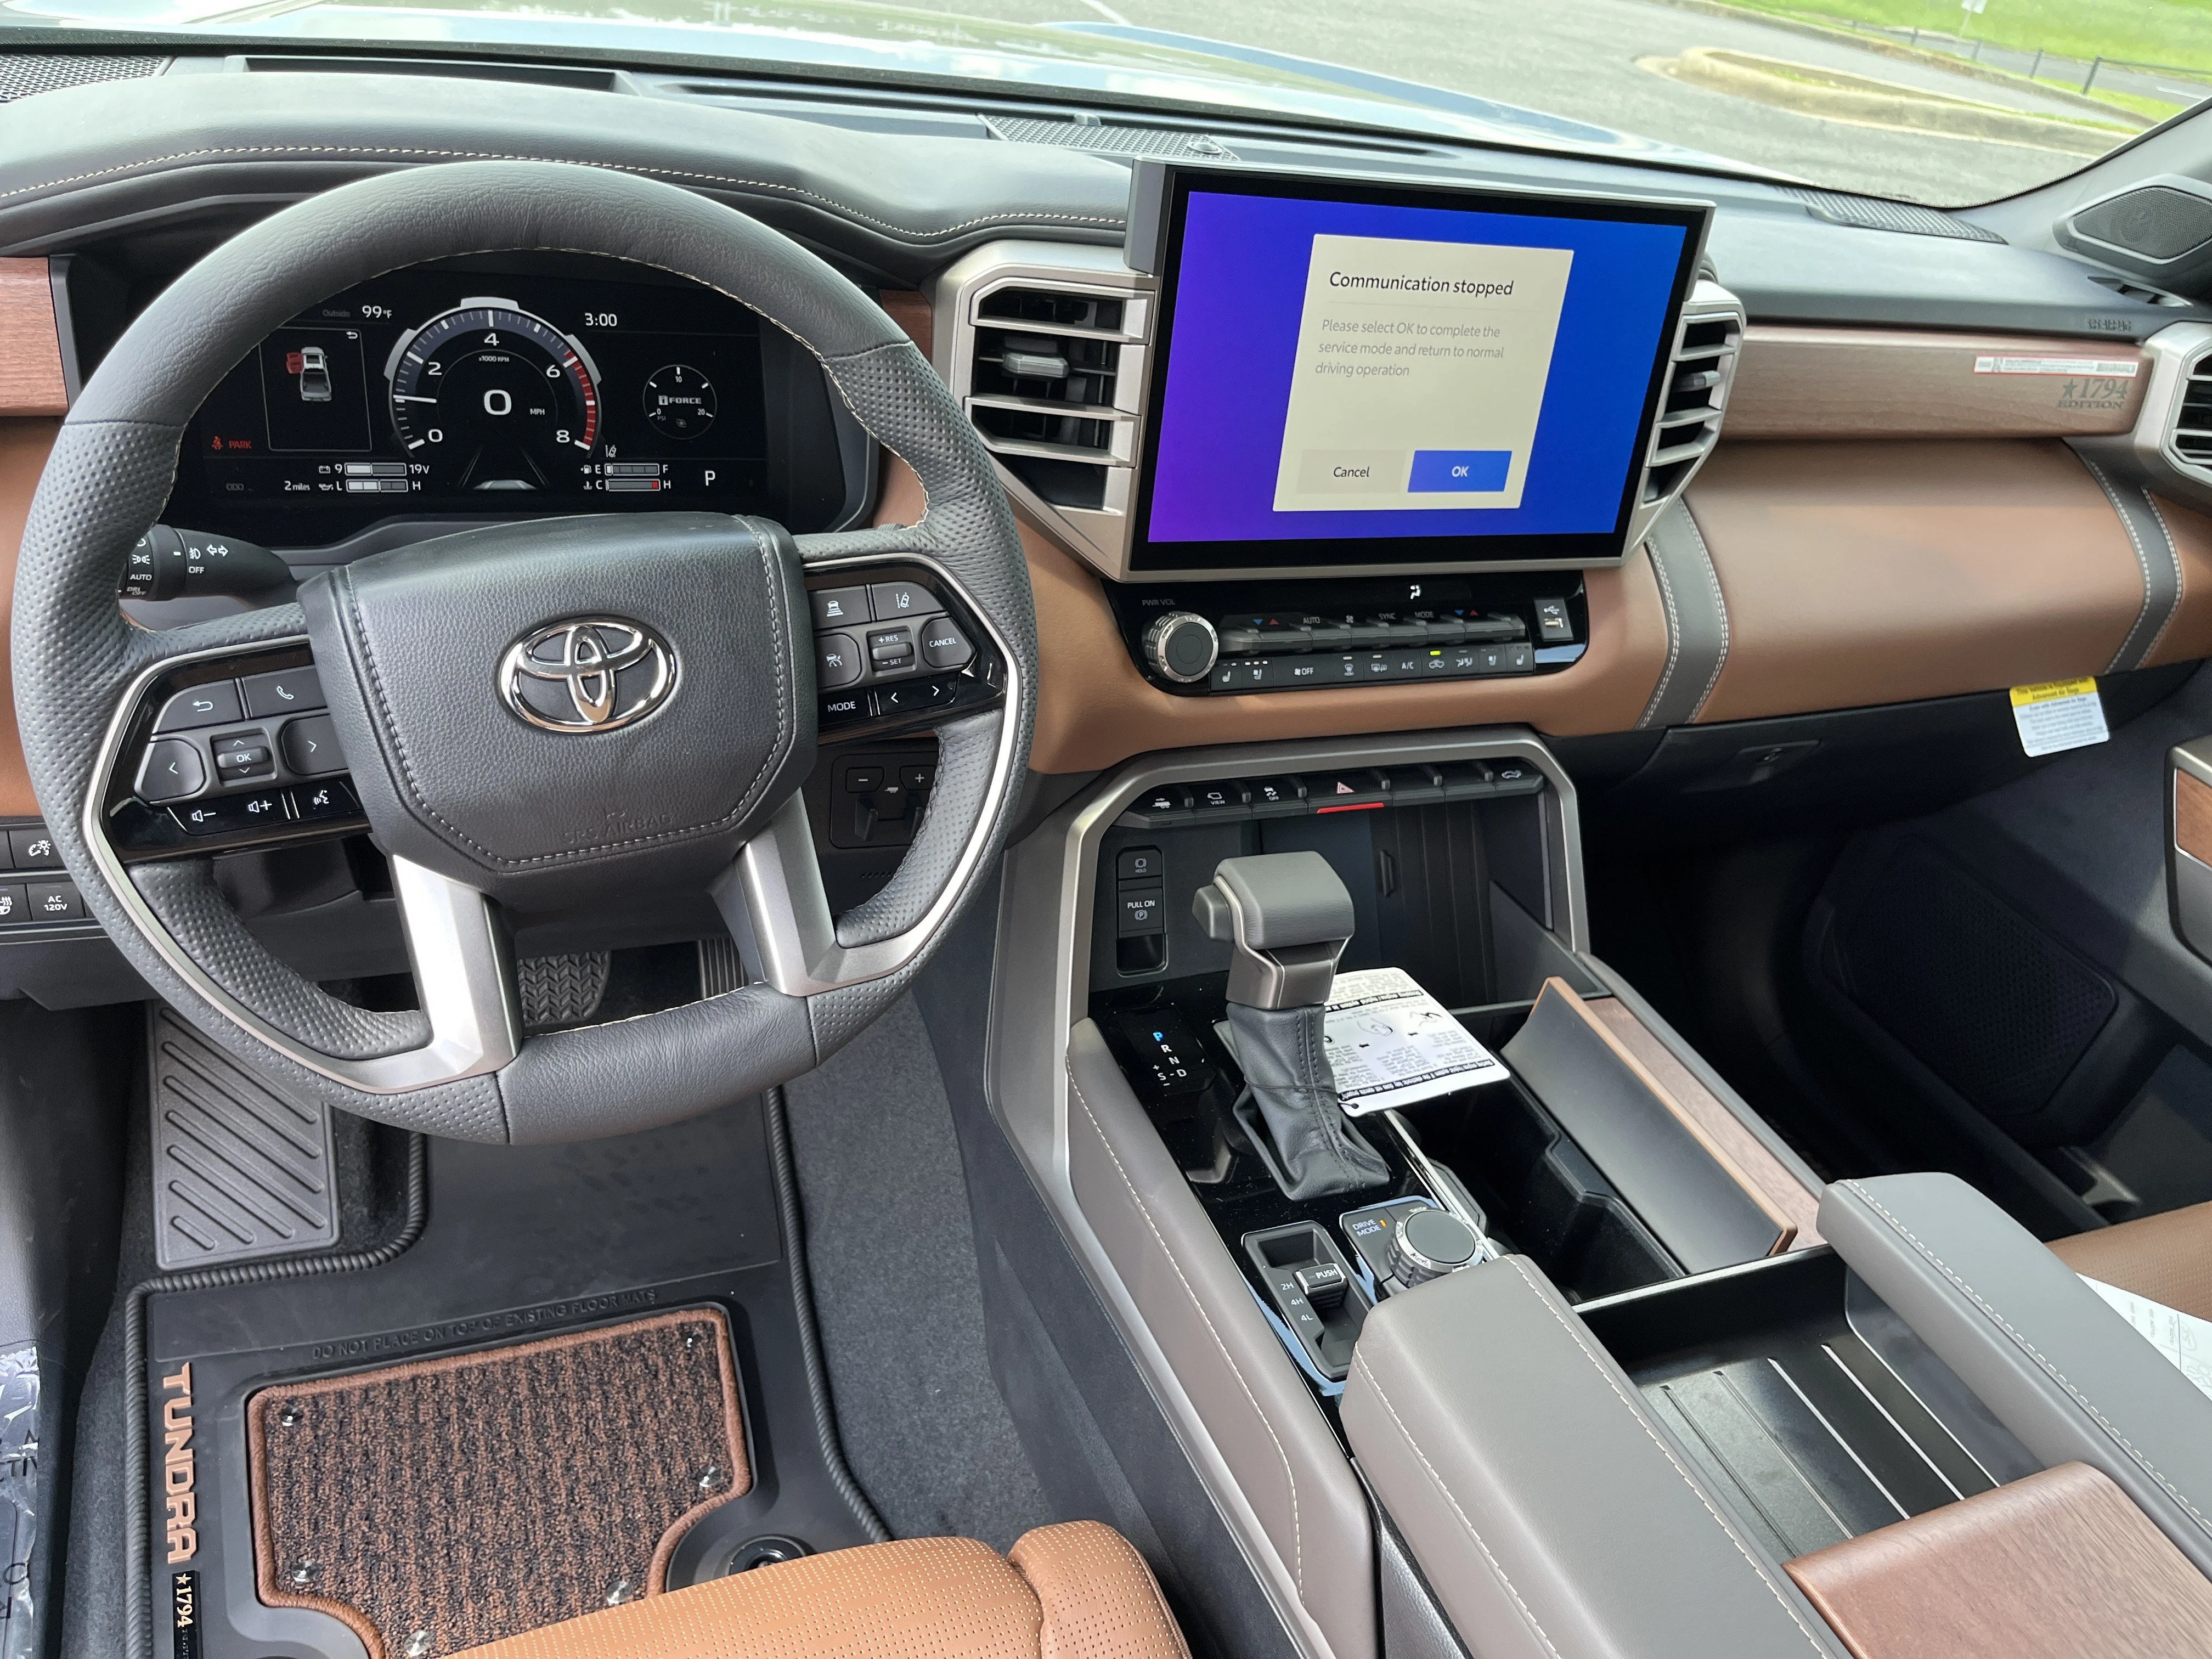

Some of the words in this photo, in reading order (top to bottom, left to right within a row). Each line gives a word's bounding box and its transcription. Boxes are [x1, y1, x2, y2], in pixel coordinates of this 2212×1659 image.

[1329, 272, 1449, 292] Communication
[1453, 279, 1514, 298] stopped
[584, 313, 617, 326] 3:00
[1322, 319, 1359, 332] Please
[1362, 321, 1394, 334] select
[1397, 323, 1415, 334] OK
[1417, 324, 1427, 335] to
[1430, 324, 1481, 338] complete
[1483, 326, 1500, 337] the
[484, 334, 499, 346] 4
[1318, 342, 1357, 354] service
[1360, 342, 1392, 355] mode
[1394, 344, 1416, 356] and
[1418, 346, 1451, 357] return
[1454, 346, 1464, 357] to
[1466, 347, 1504, 358] normal
[428, 362, 442, 375] 2
[546, 365, 560, 377] 6
[1316, 362, 1353, 377] driving
[1356, 364, 1409, 377] operation
[2079, 379, 2129, 399] 1794
[484, 390, 511, 415] 0
[2057, 400, 2125, 410] EDITION
[428, 429, 443, 442] 0
[556, 430, 570, 443] 8
[229, 441, 252, 449] PARK
[334, 465, 342, 473] 9
[409, 465, 430, 474] 19V
[595, 465, 601, 474] E
[663, 465, 668, 474] F
[1333, 465, 1370, 478] Cancel
[1451, 465, 1469, 478] OK
[664, 480, 671, 489] H
[705, 471, 715, 486] P
[336, 482, 342, 491] L
[413, 482, 420, 491] H
[596, 481, 603, 490] C
[189, 566, 205, 574] OFF
[1379, 612, 1396, 620] SYNC
[929, 637, 957, 648] CANCEL
[827, 701, 856, 712] MODE
[236, 753, 252, 763] OK
[1153, 1031, 1164, 1042] P
[1161, 1044, 1172, 1053] R
[1169, 1056, 1180, 1065] N
[1352, 1219, 1377, 1231] DRIVE
[1356, 1224, 1382, 1237] MODE
[1316, 1268, 1339, 1280] PUSH
[313, 1345, 334, 1359] DO
[338, 1340, 367, 1357] NOT
[373, 1330, 419, 1351] PLACE
[424, 1328, 445, 1342] ON
[505, 1305, 567, 1327] EXISTING
[571, 1296, 619, 1314] FLOOR
[163, 1361, 198, 1564] TUNDRA
[176, 1586, 193, 1628] 1794
